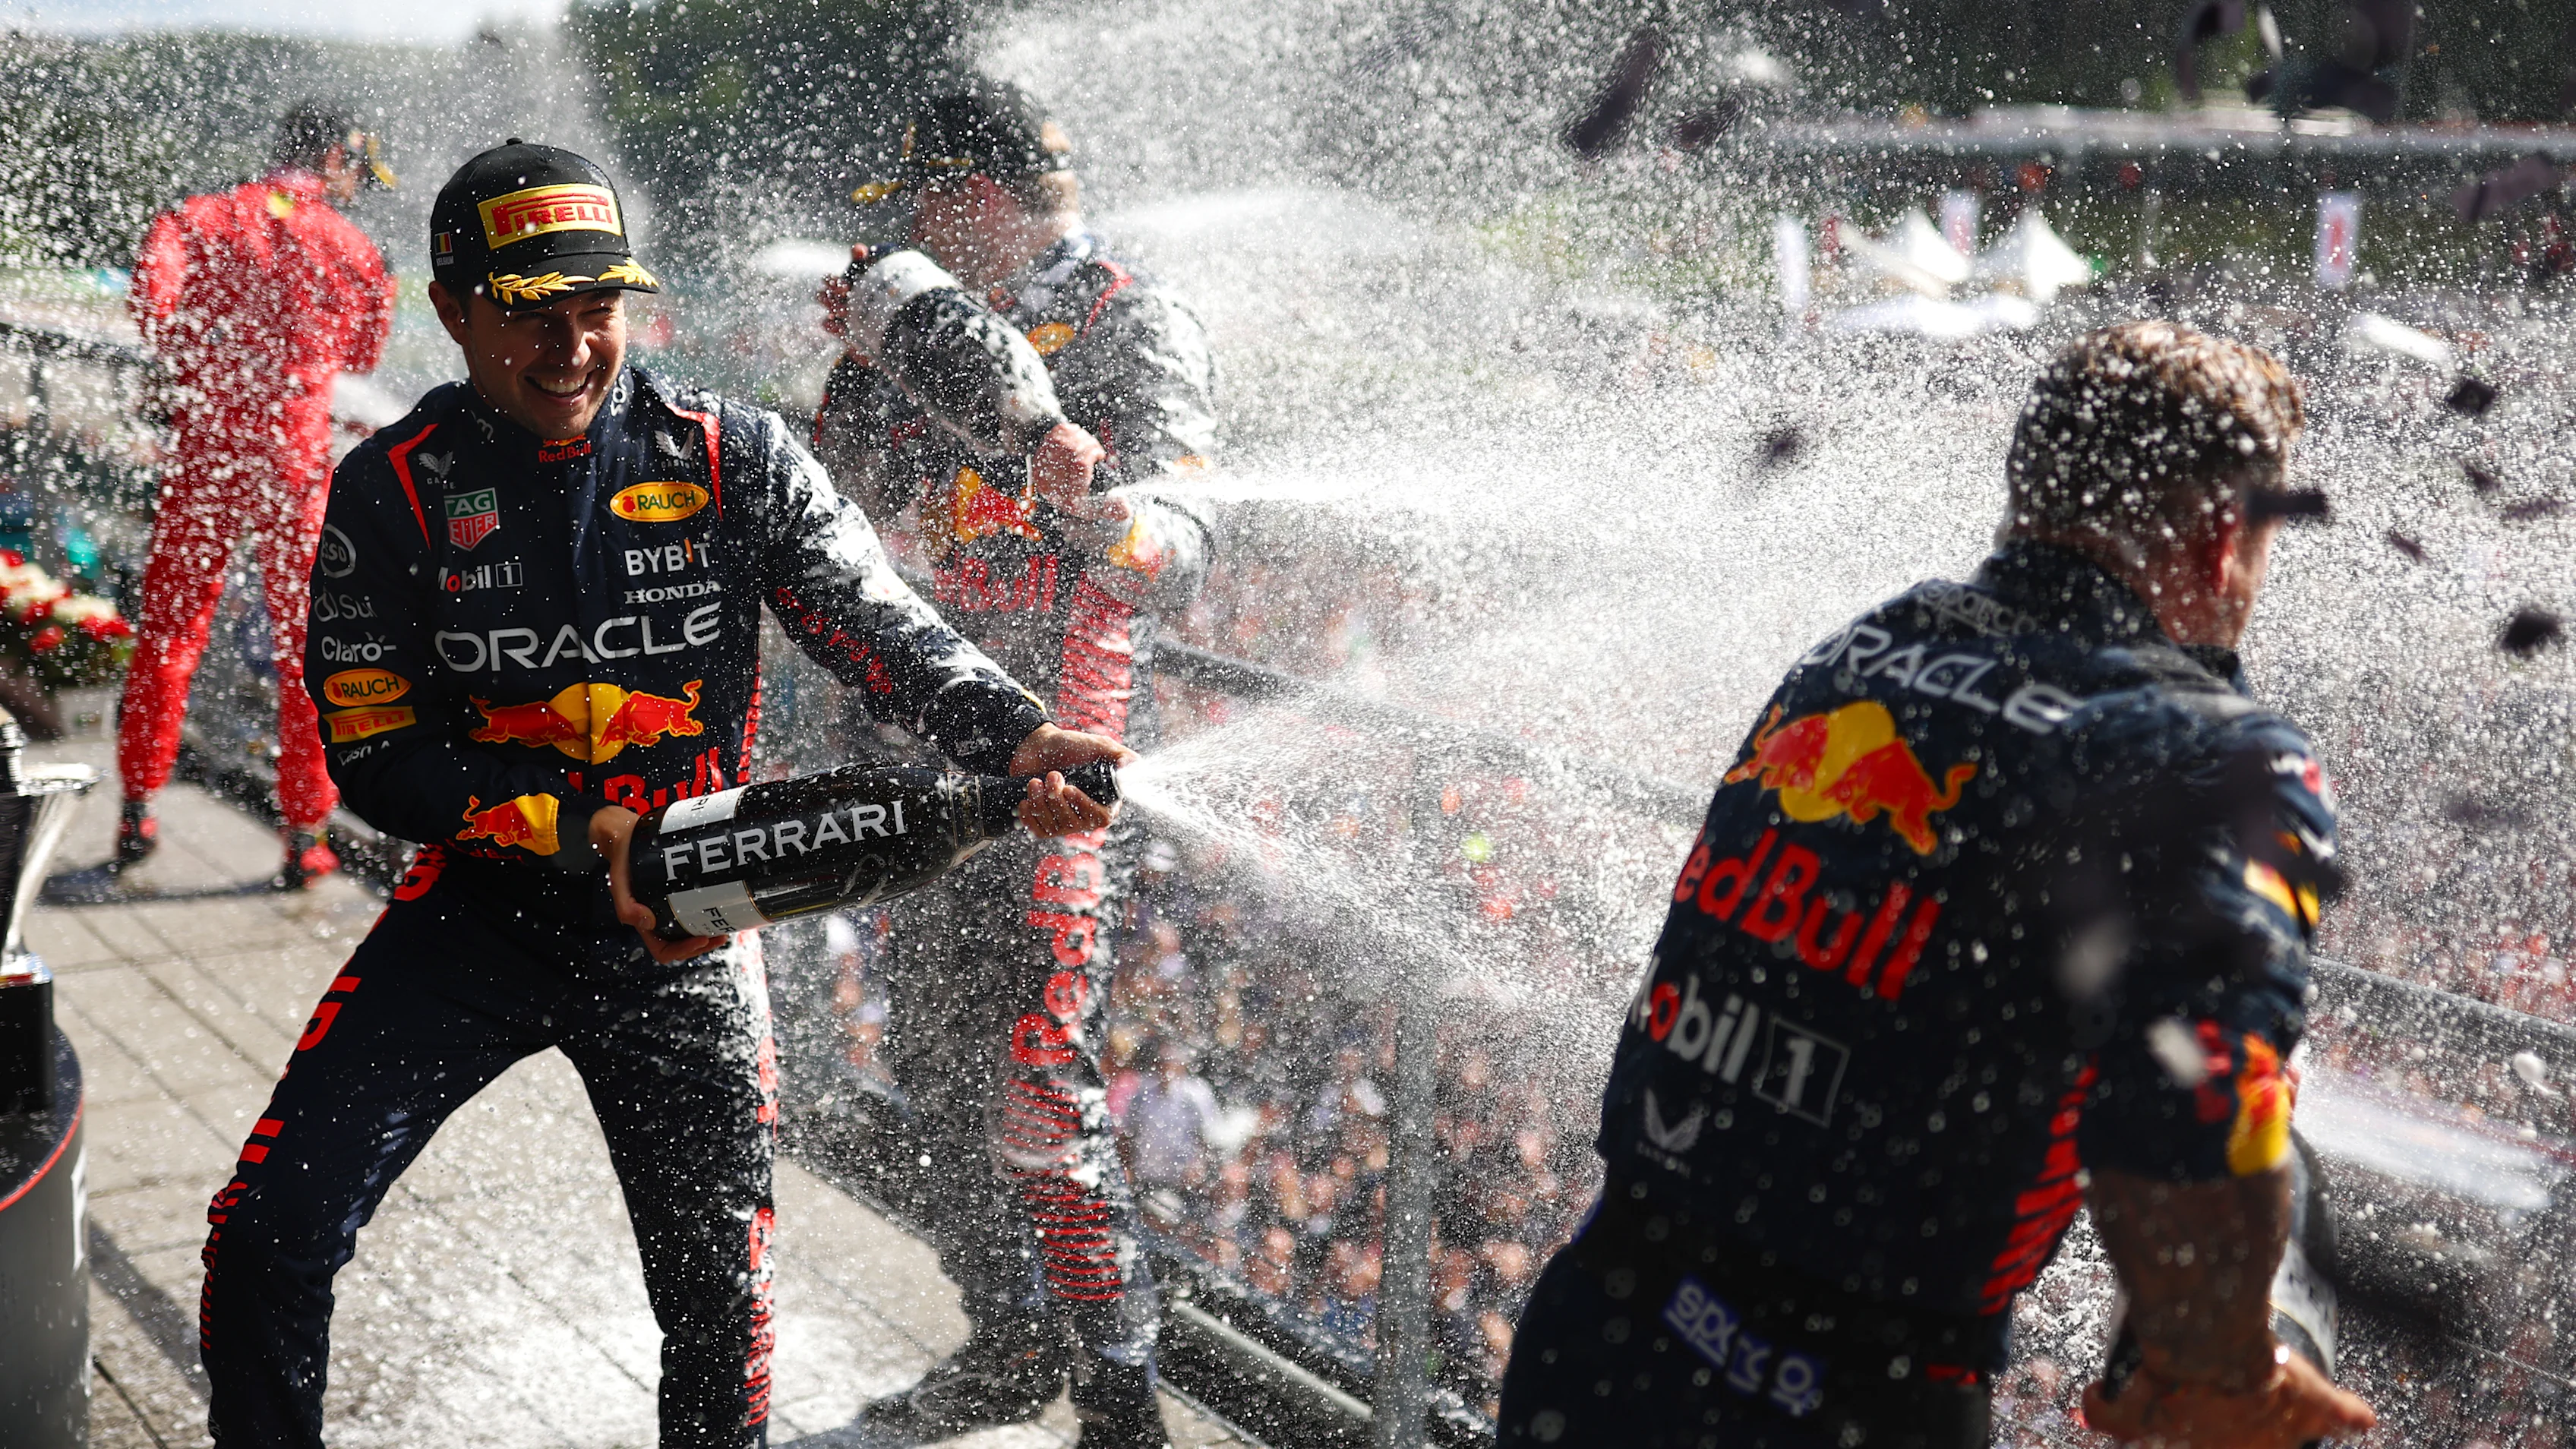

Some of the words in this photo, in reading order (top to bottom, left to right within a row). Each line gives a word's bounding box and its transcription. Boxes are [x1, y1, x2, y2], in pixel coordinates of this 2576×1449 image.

[491, 192, 613, 237] PIRELLI
[538, 450, 565, 462] Red
[567, 444, 591, 459] Bull
[638, 491, 696, 510] RAUCH
[450, 515, 495, 546] EUER
[624, 538, 710, 576] BYBIT
[623, 580, 721, 604] HONDA
[321, 636, 383, 662] Claro
[434, 601, 721, 671] ORACLE
[340, 676, 400, 698] RAUCH
[332, 711, 405, 736] PIRELLI
[661, 800, 909, 882] FERRARI
[1674, 826, 1779, 922] ed
[1739, 842, 1941, 1001] Bull
